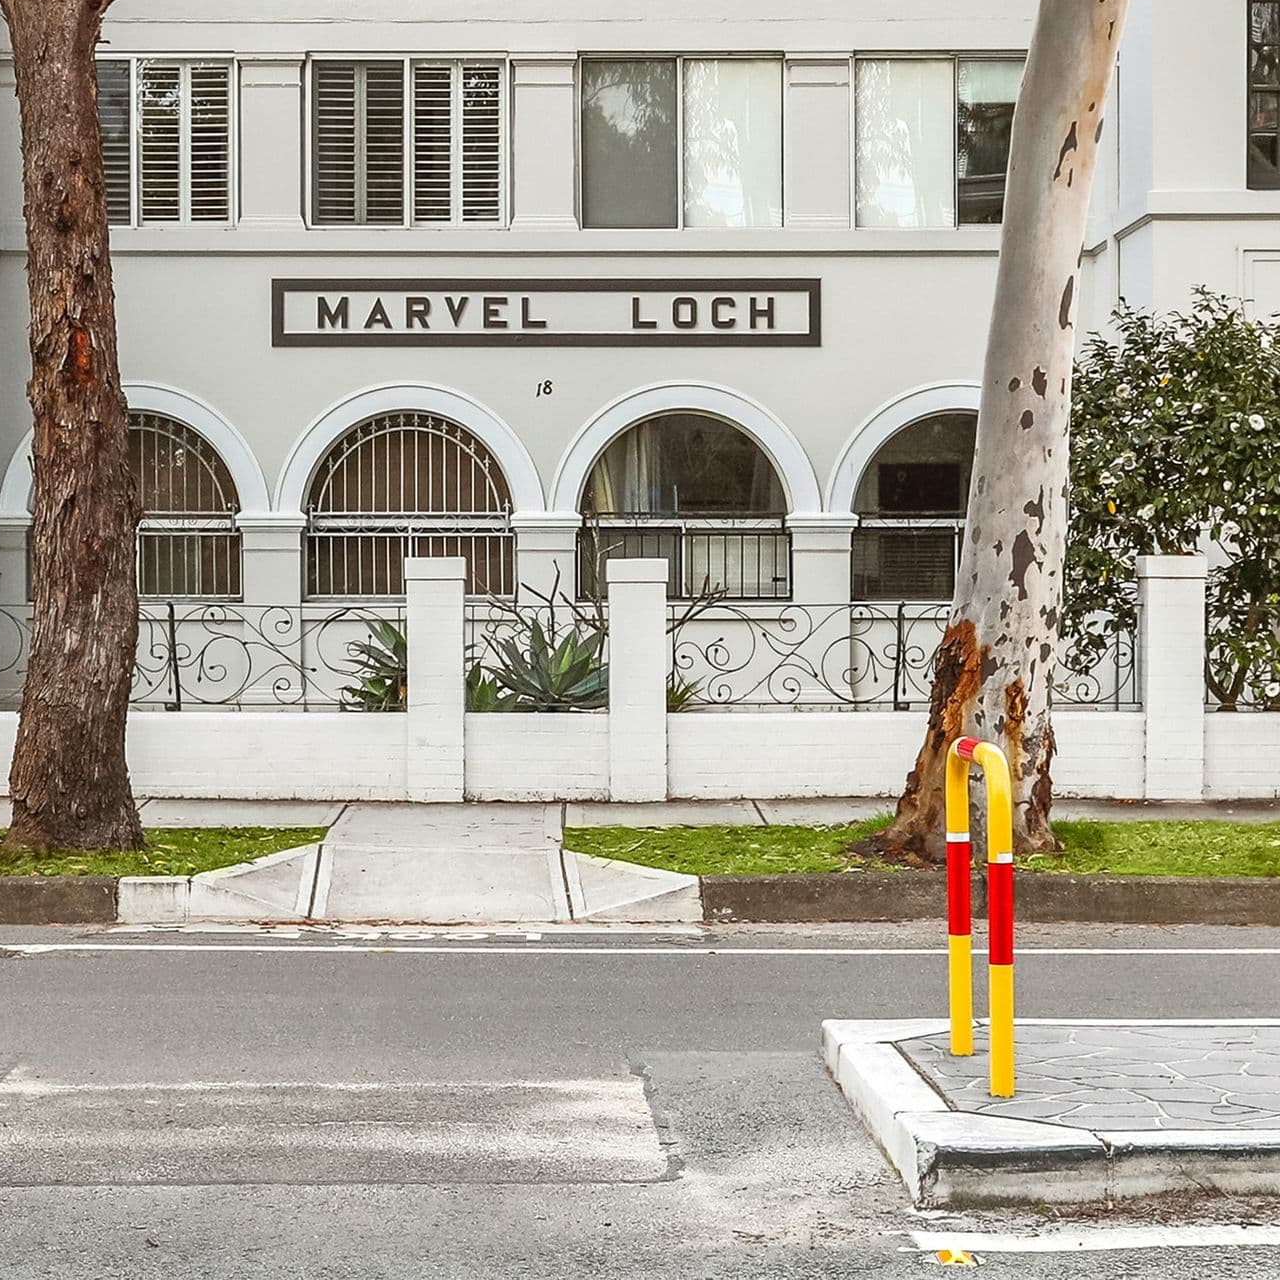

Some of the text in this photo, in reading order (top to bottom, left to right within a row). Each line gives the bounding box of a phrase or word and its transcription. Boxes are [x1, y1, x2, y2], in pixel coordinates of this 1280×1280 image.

[317, 296, 775, 329] MARVEL LOCH
[536, 379, 553, 398] 18
[331, 932, 543, 941] LOOK
